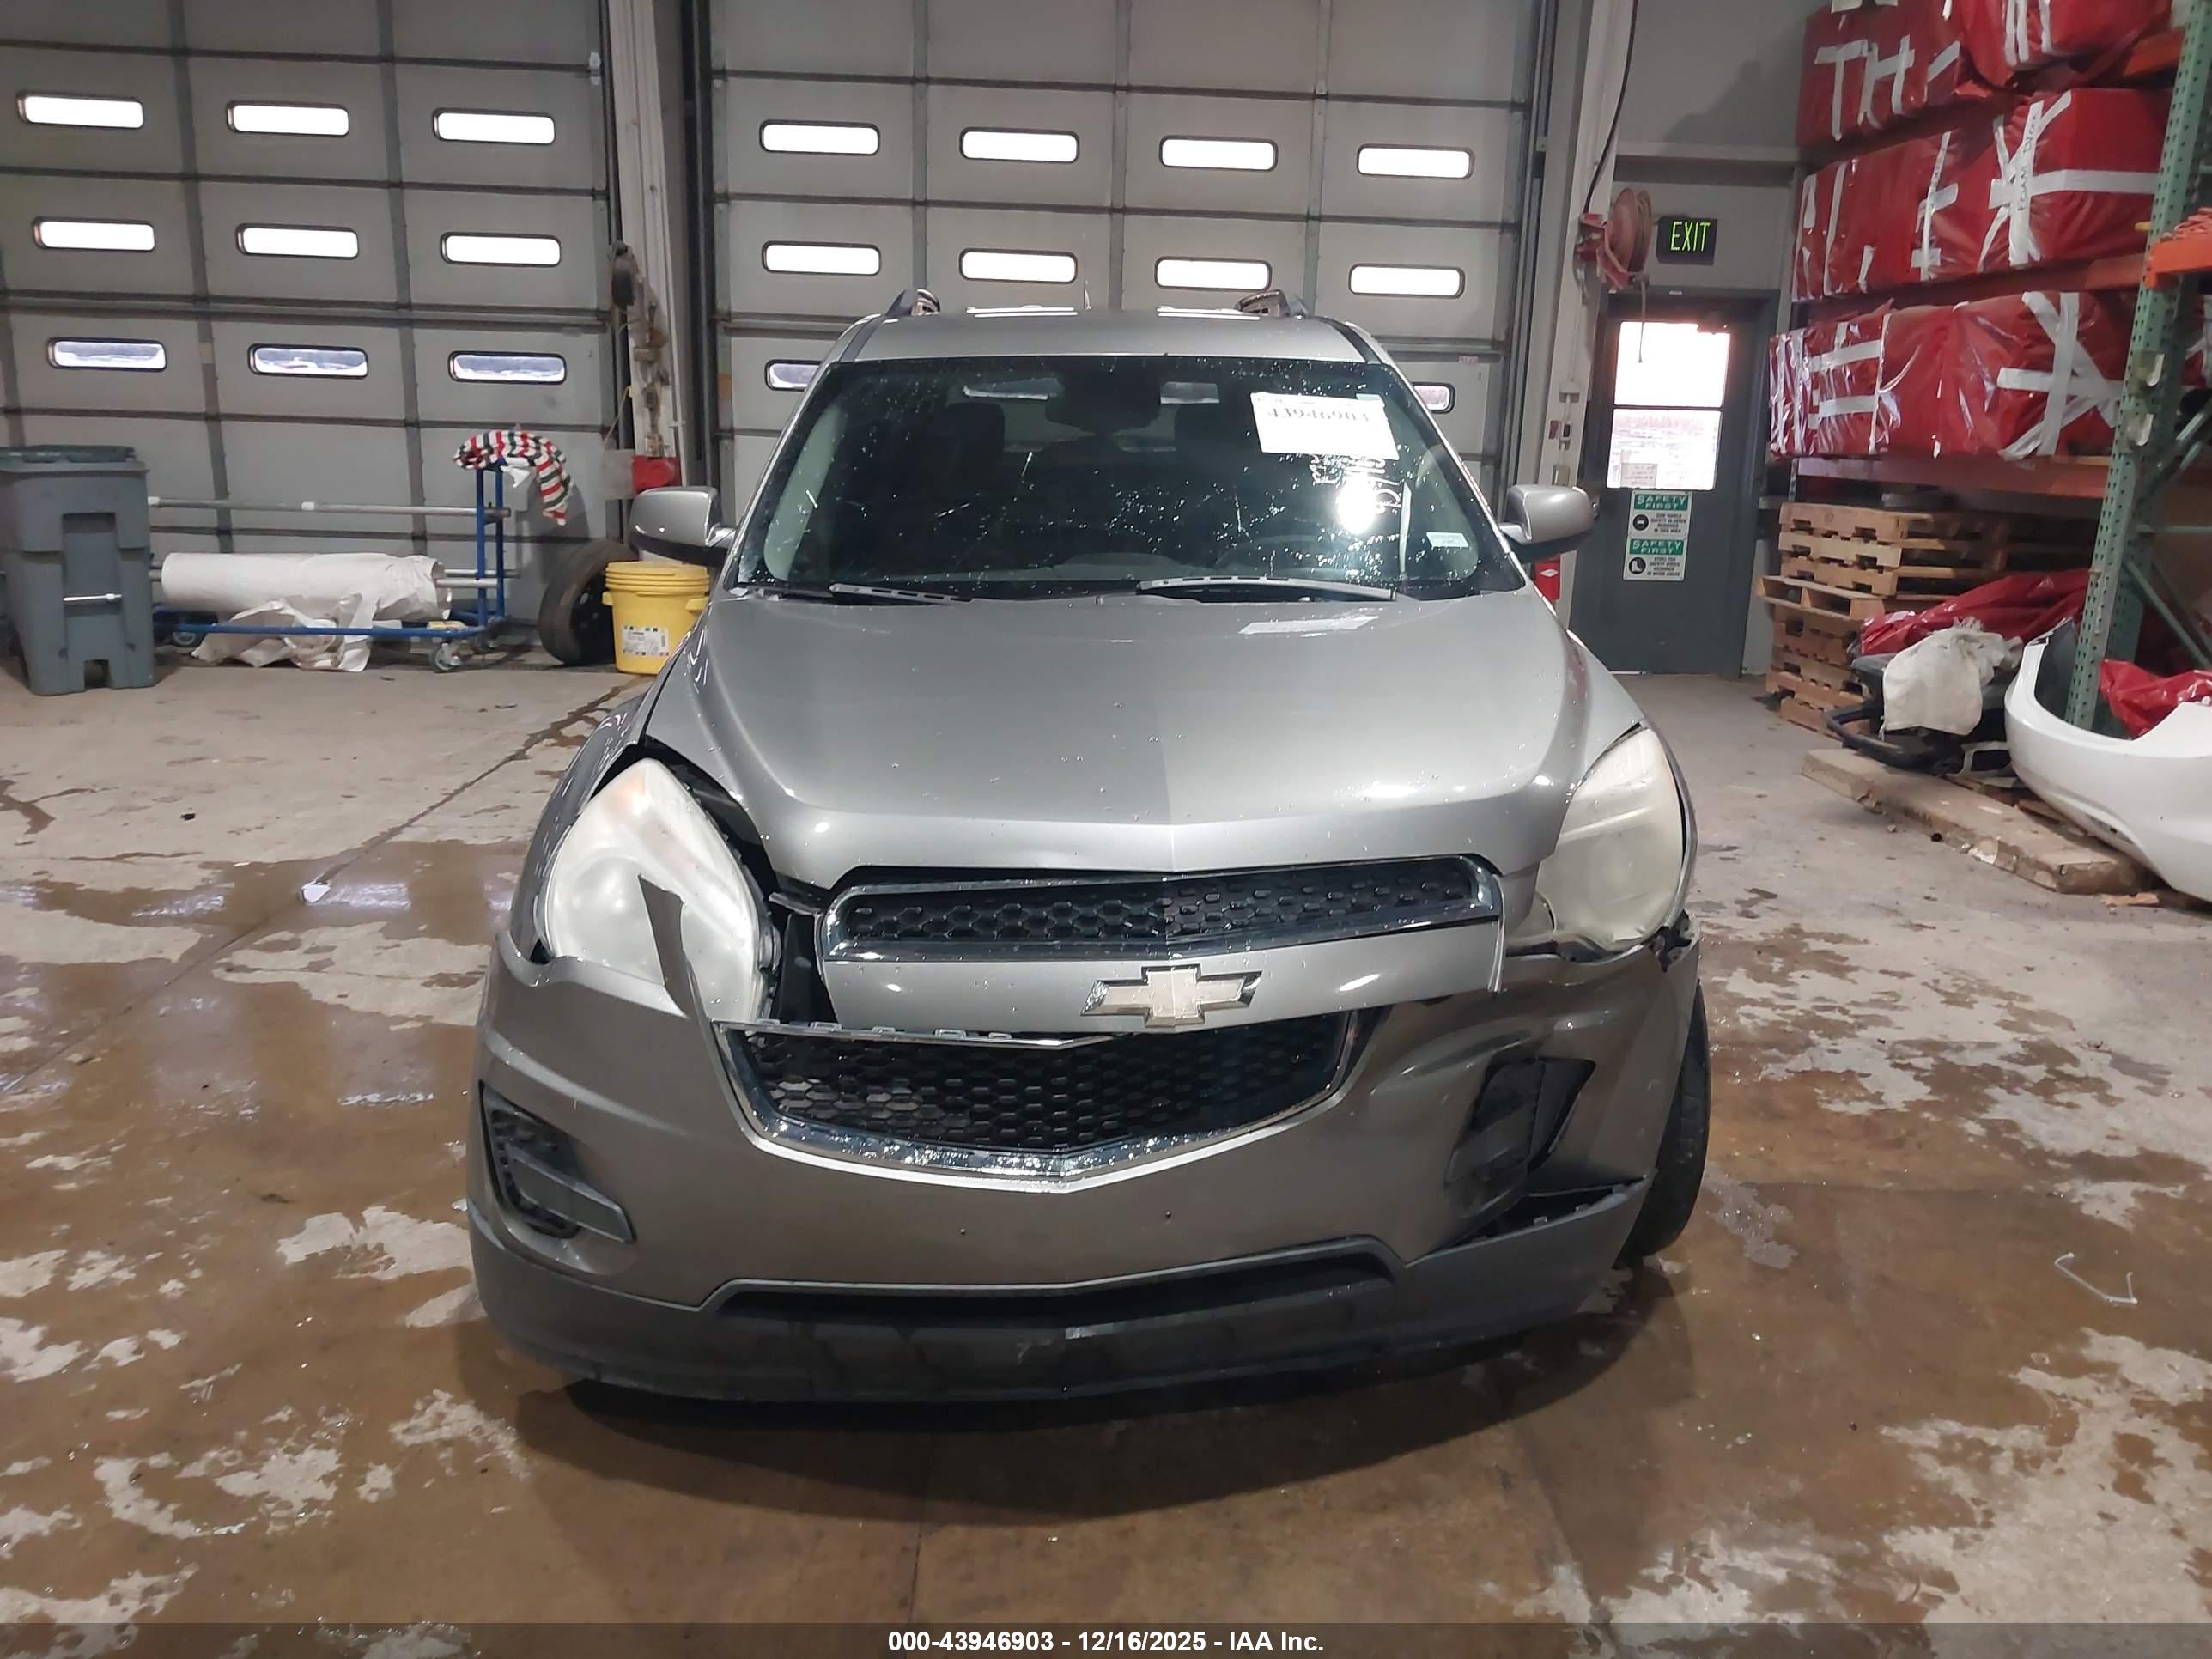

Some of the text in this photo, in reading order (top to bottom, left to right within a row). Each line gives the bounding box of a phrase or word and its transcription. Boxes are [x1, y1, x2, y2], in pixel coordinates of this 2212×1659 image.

[1670, 221, 1711, 252] EXIT
[1637, 495, 1686, 505] SAFETY
[1632, 539, 1682, 550] SAFETY
